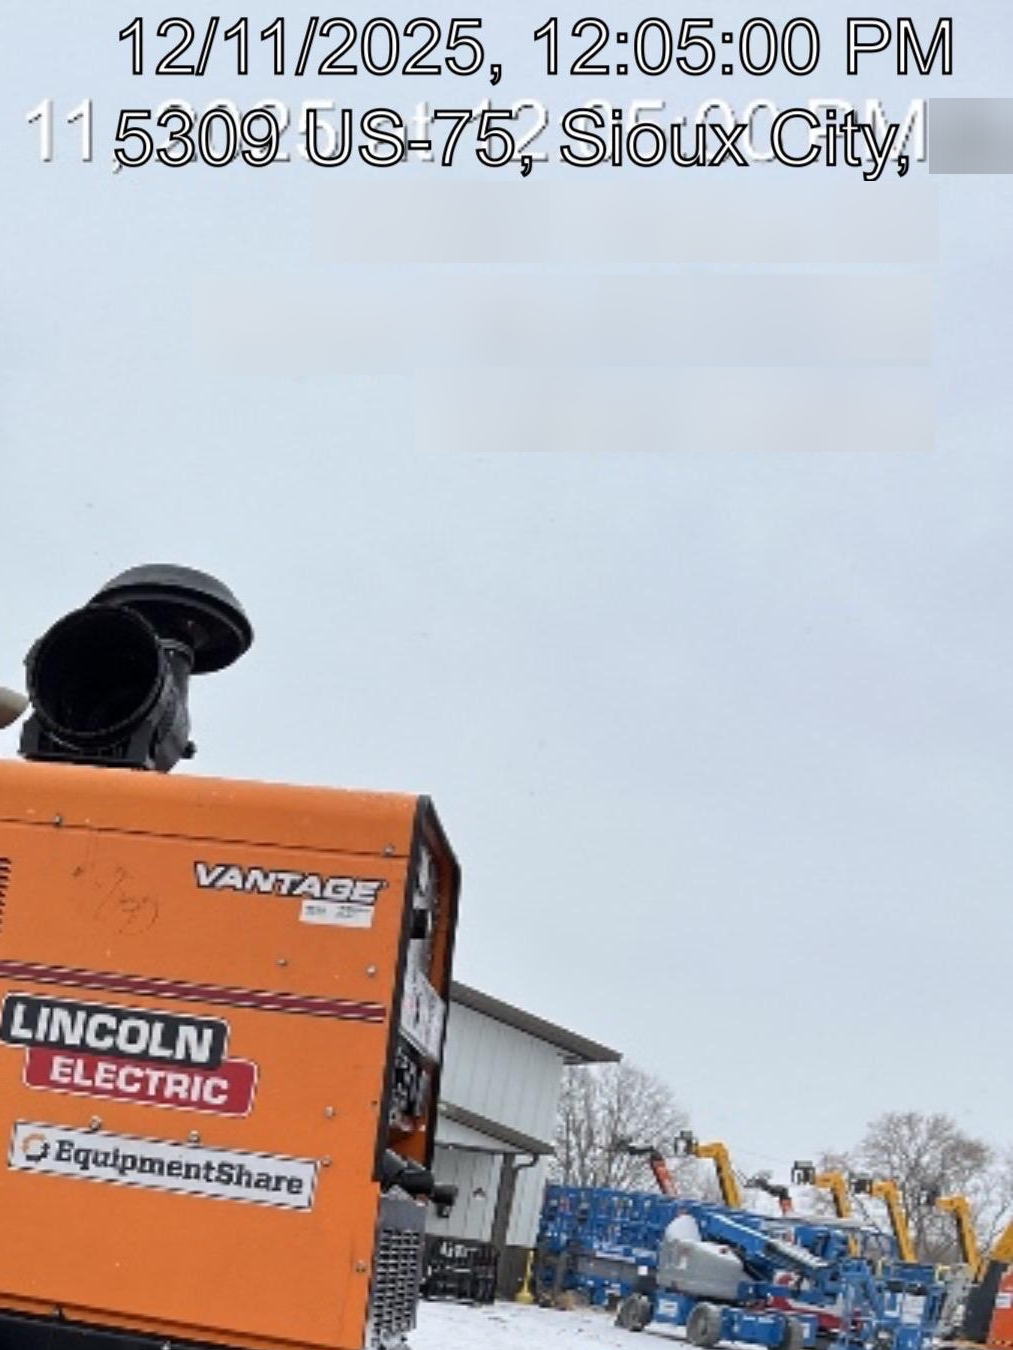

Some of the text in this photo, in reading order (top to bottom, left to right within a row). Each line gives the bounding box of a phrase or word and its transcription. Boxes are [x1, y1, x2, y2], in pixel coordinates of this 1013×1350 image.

[195, 861, 384, 902] VANTAGE
[9, 1002, 214, 1063] LINCOLN
[49, 1055, 229, 1106] ELECTRIC
[54, 1139, 304, 1195] EquipmentShare
